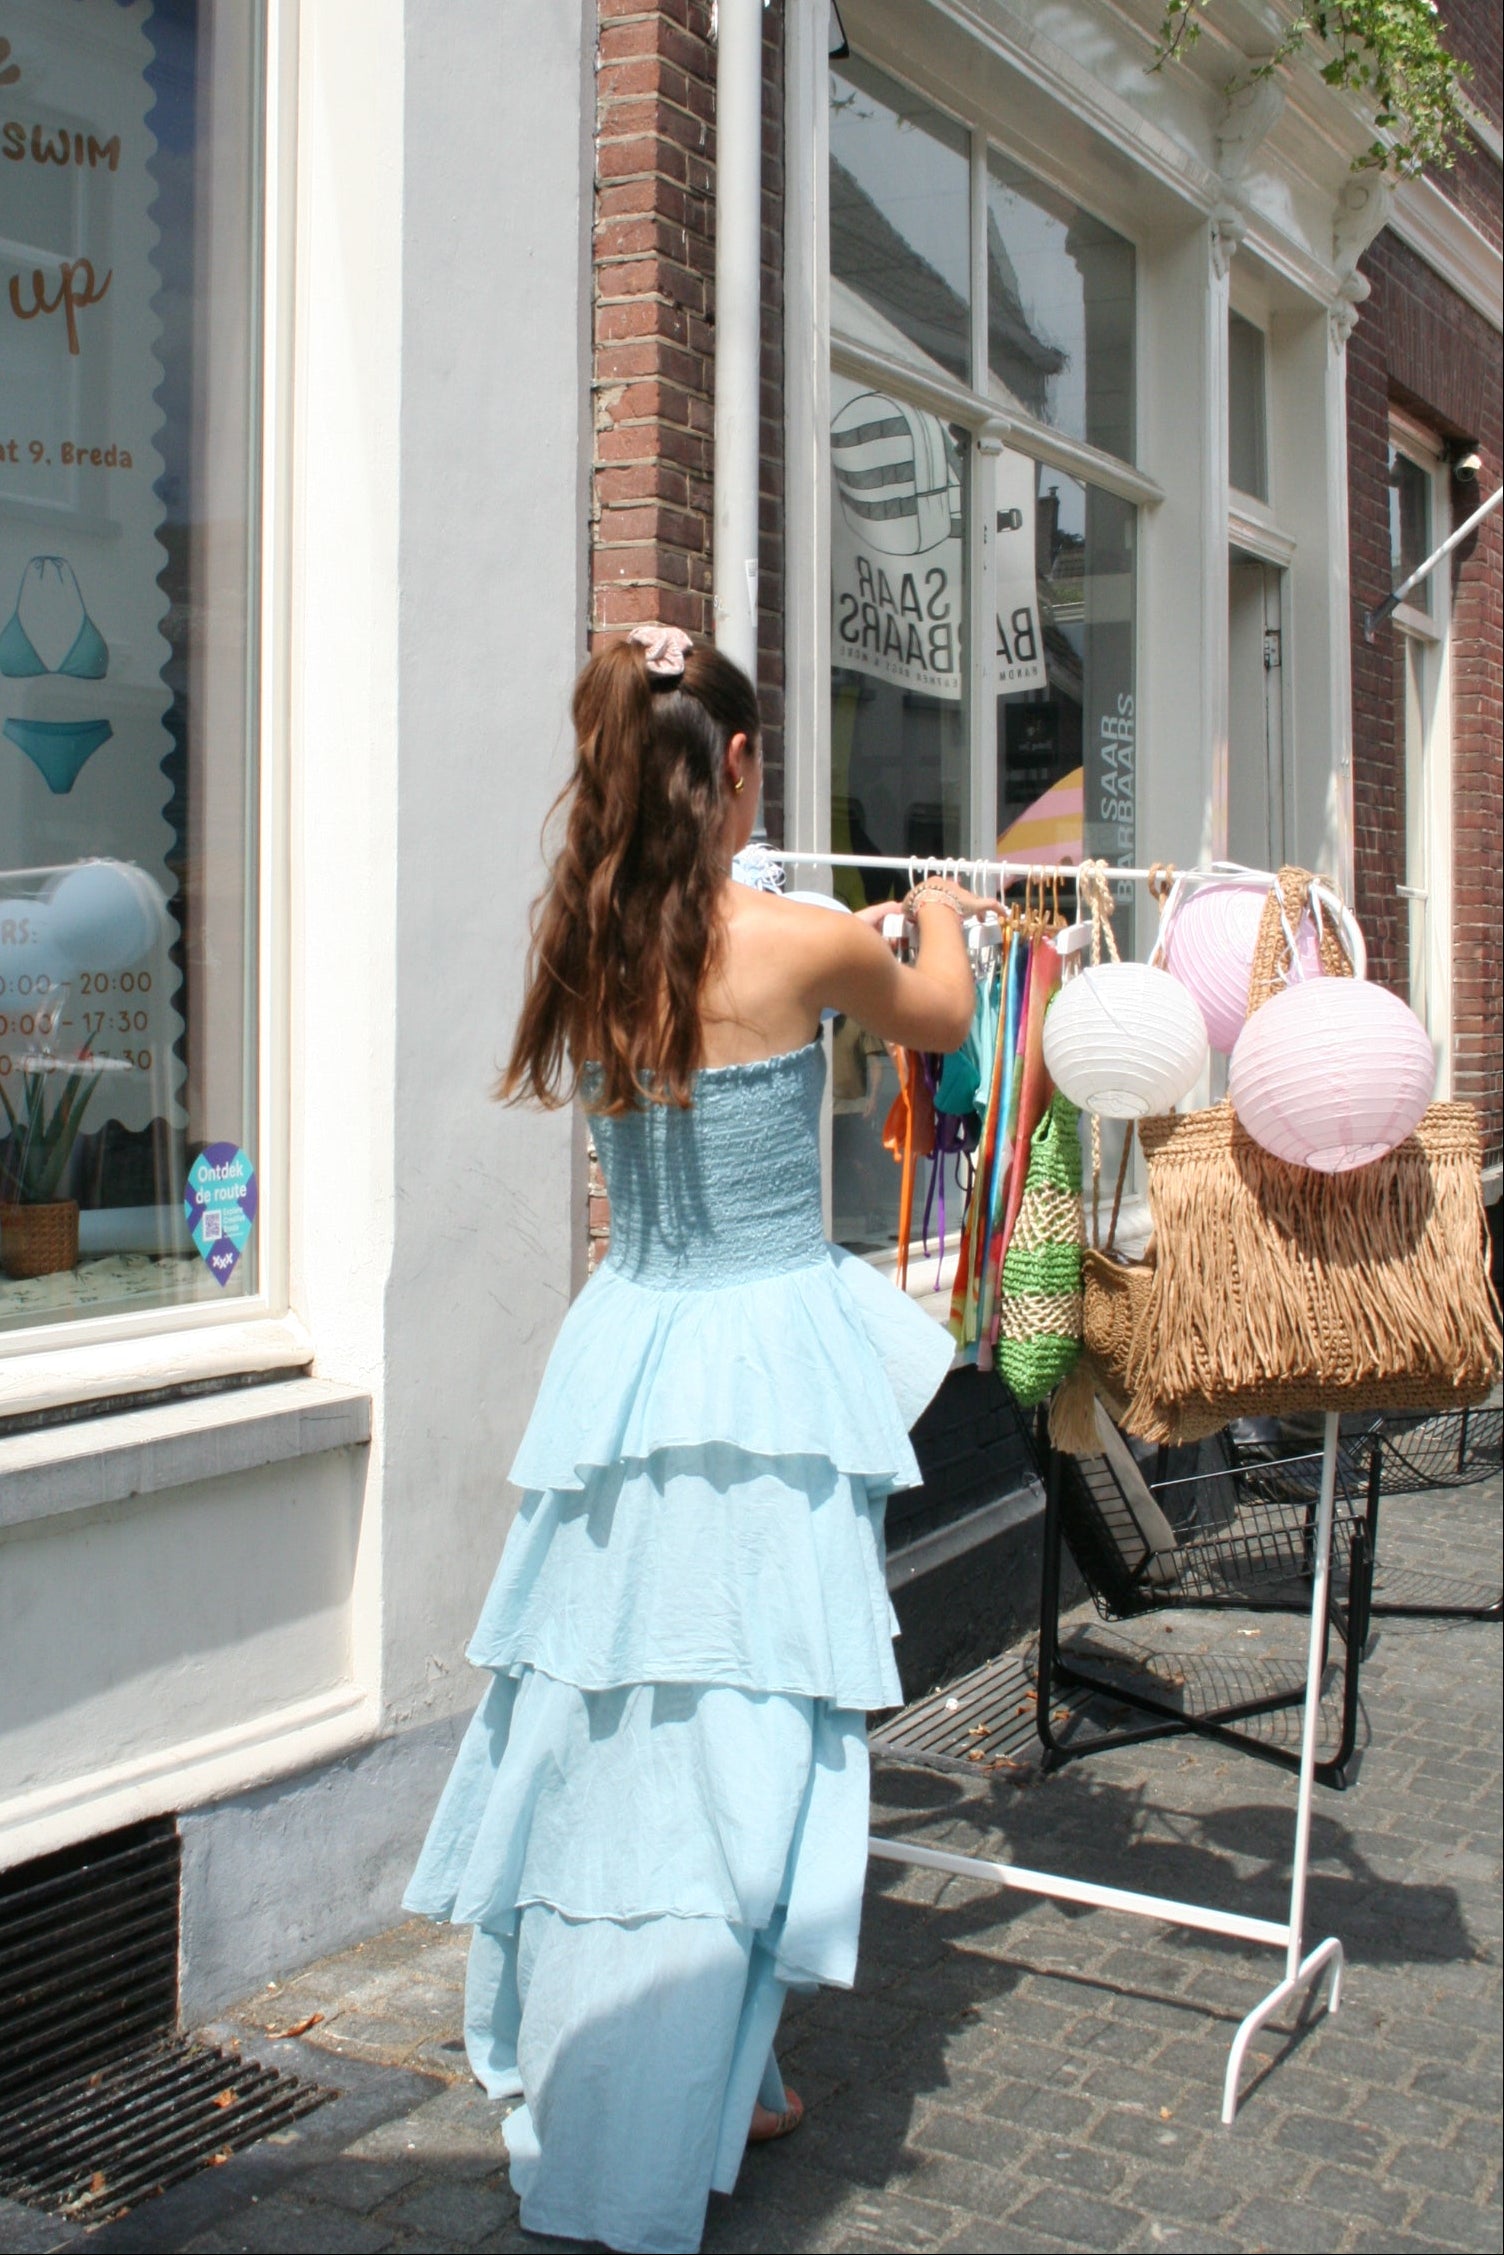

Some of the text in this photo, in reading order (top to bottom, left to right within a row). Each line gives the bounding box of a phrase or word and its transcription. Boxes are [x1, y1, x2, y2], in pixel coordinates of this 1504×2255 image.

[3, 121, 121, 172] SWIM
[9, 257, 113, 355] up
[61, 441, 133, 469] Breda
[1101, 715, 1118, 821] SAAR
[80, 971, 152, 996] 20:00
[83, 1010, 148, 1033] 17:30
[197, 1161, 244, 1183] Ontdek
[195, 1184, 248, 1205] de route
